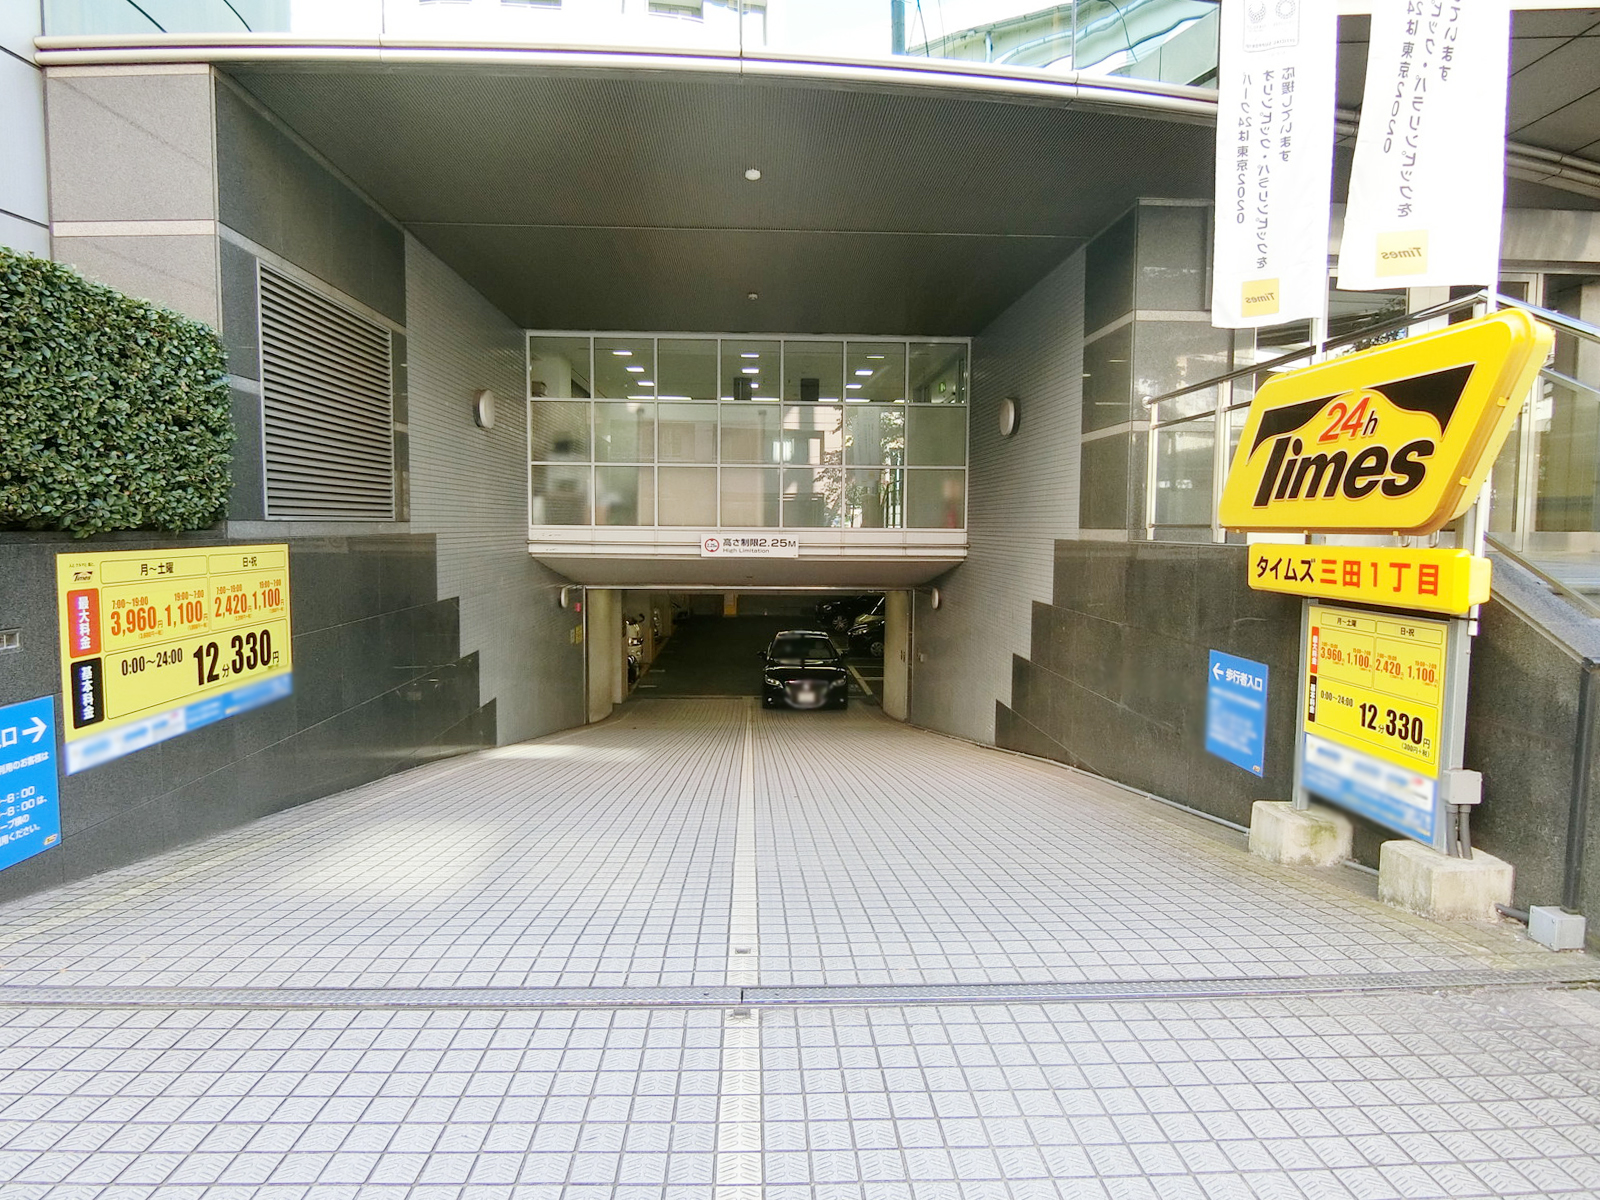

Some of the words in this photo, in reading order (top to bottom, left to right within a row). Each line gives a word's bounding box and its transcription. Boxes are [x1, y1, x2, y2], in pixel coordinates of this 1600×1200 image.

[1318, 397, 1378, 442] 24h
[1253, 436, 1435, 507] Times
[1225, 668, 1263, 692] 歩行者入口
